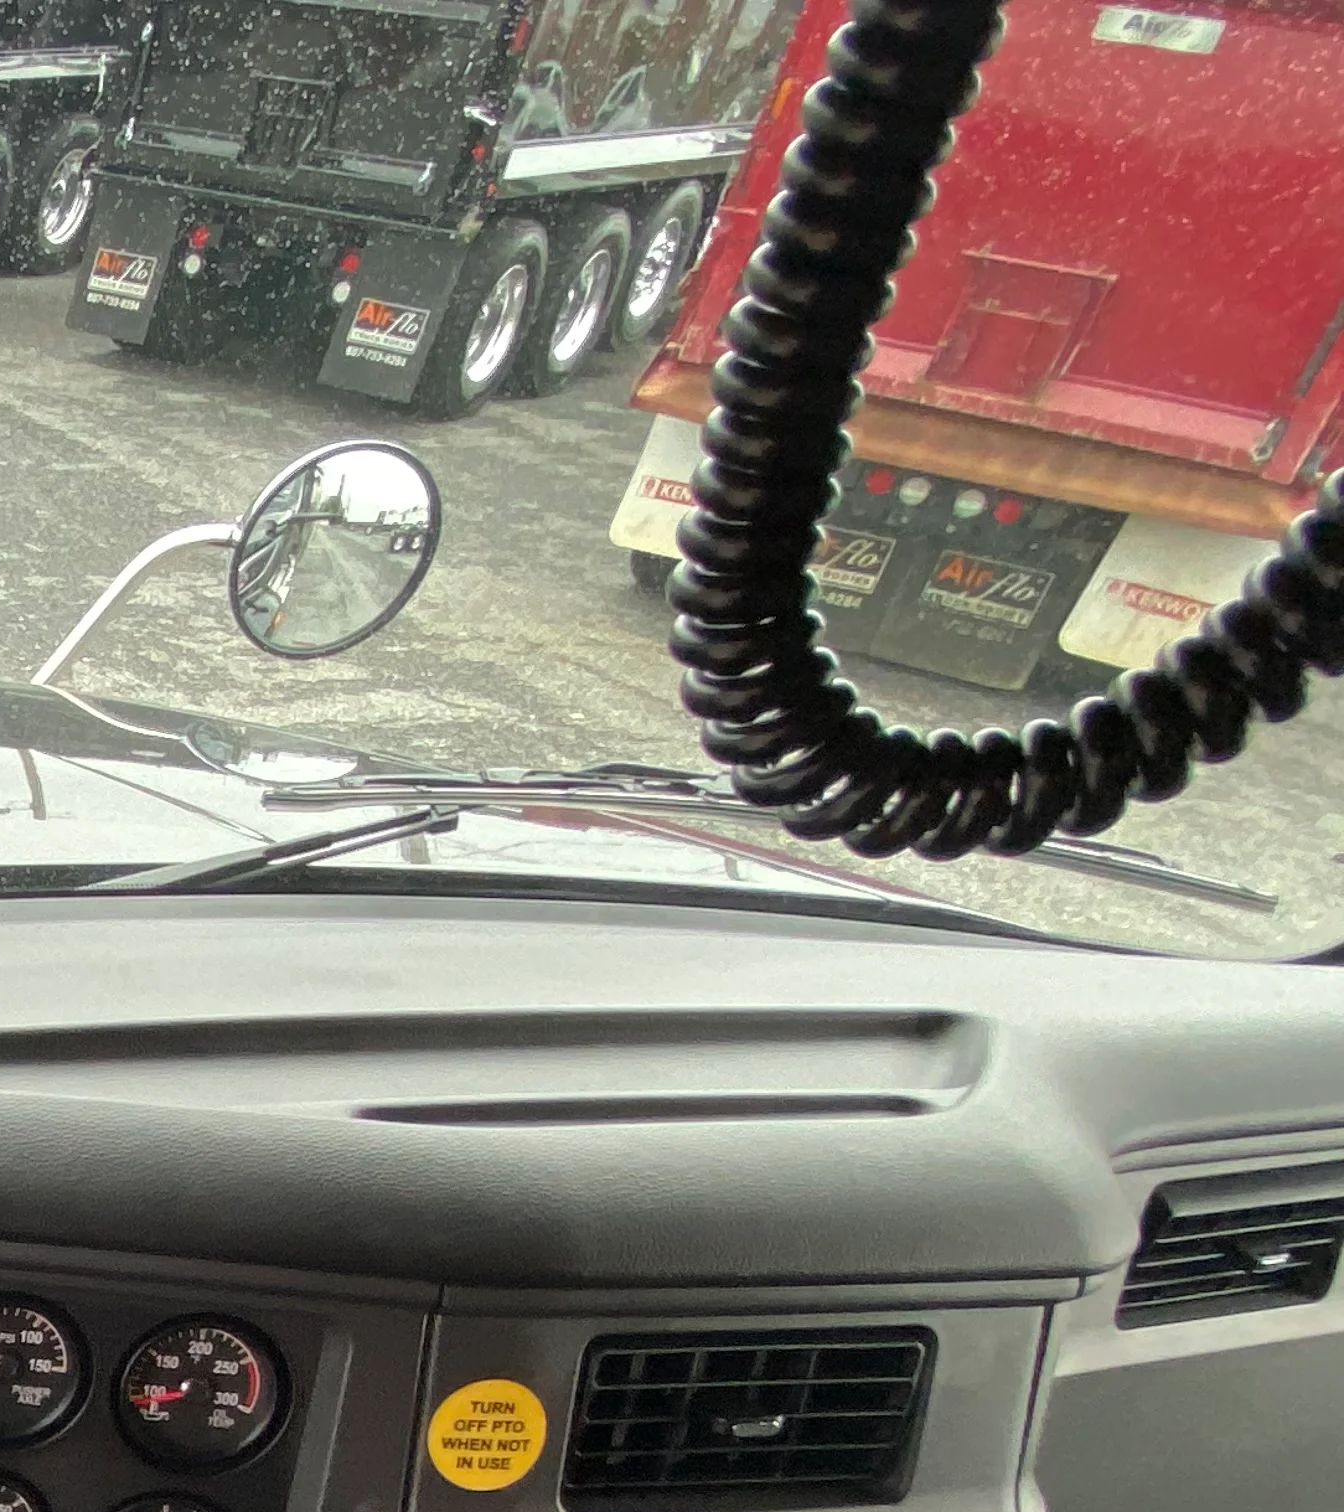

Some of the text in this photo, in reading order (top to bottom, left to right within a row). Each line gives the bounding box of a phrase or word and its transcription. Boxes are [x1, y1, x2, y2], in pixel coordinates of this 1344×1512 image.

[20, 1330, 44, 1345] 100
[187, 1341, 213, 1356] 200
[28, 1358, 52, 1373] 150
[155, 1354, 239, 1375] 150 250
[213, 1392, 239, 1406] 300
[470, 1400, 516, 1415] TURN
[453, 1419, 525, 1433] OFF PTO
[441, 1437, 531, 1452] WHEN NOT
[456, 1456, 511, 1470] IN USE
